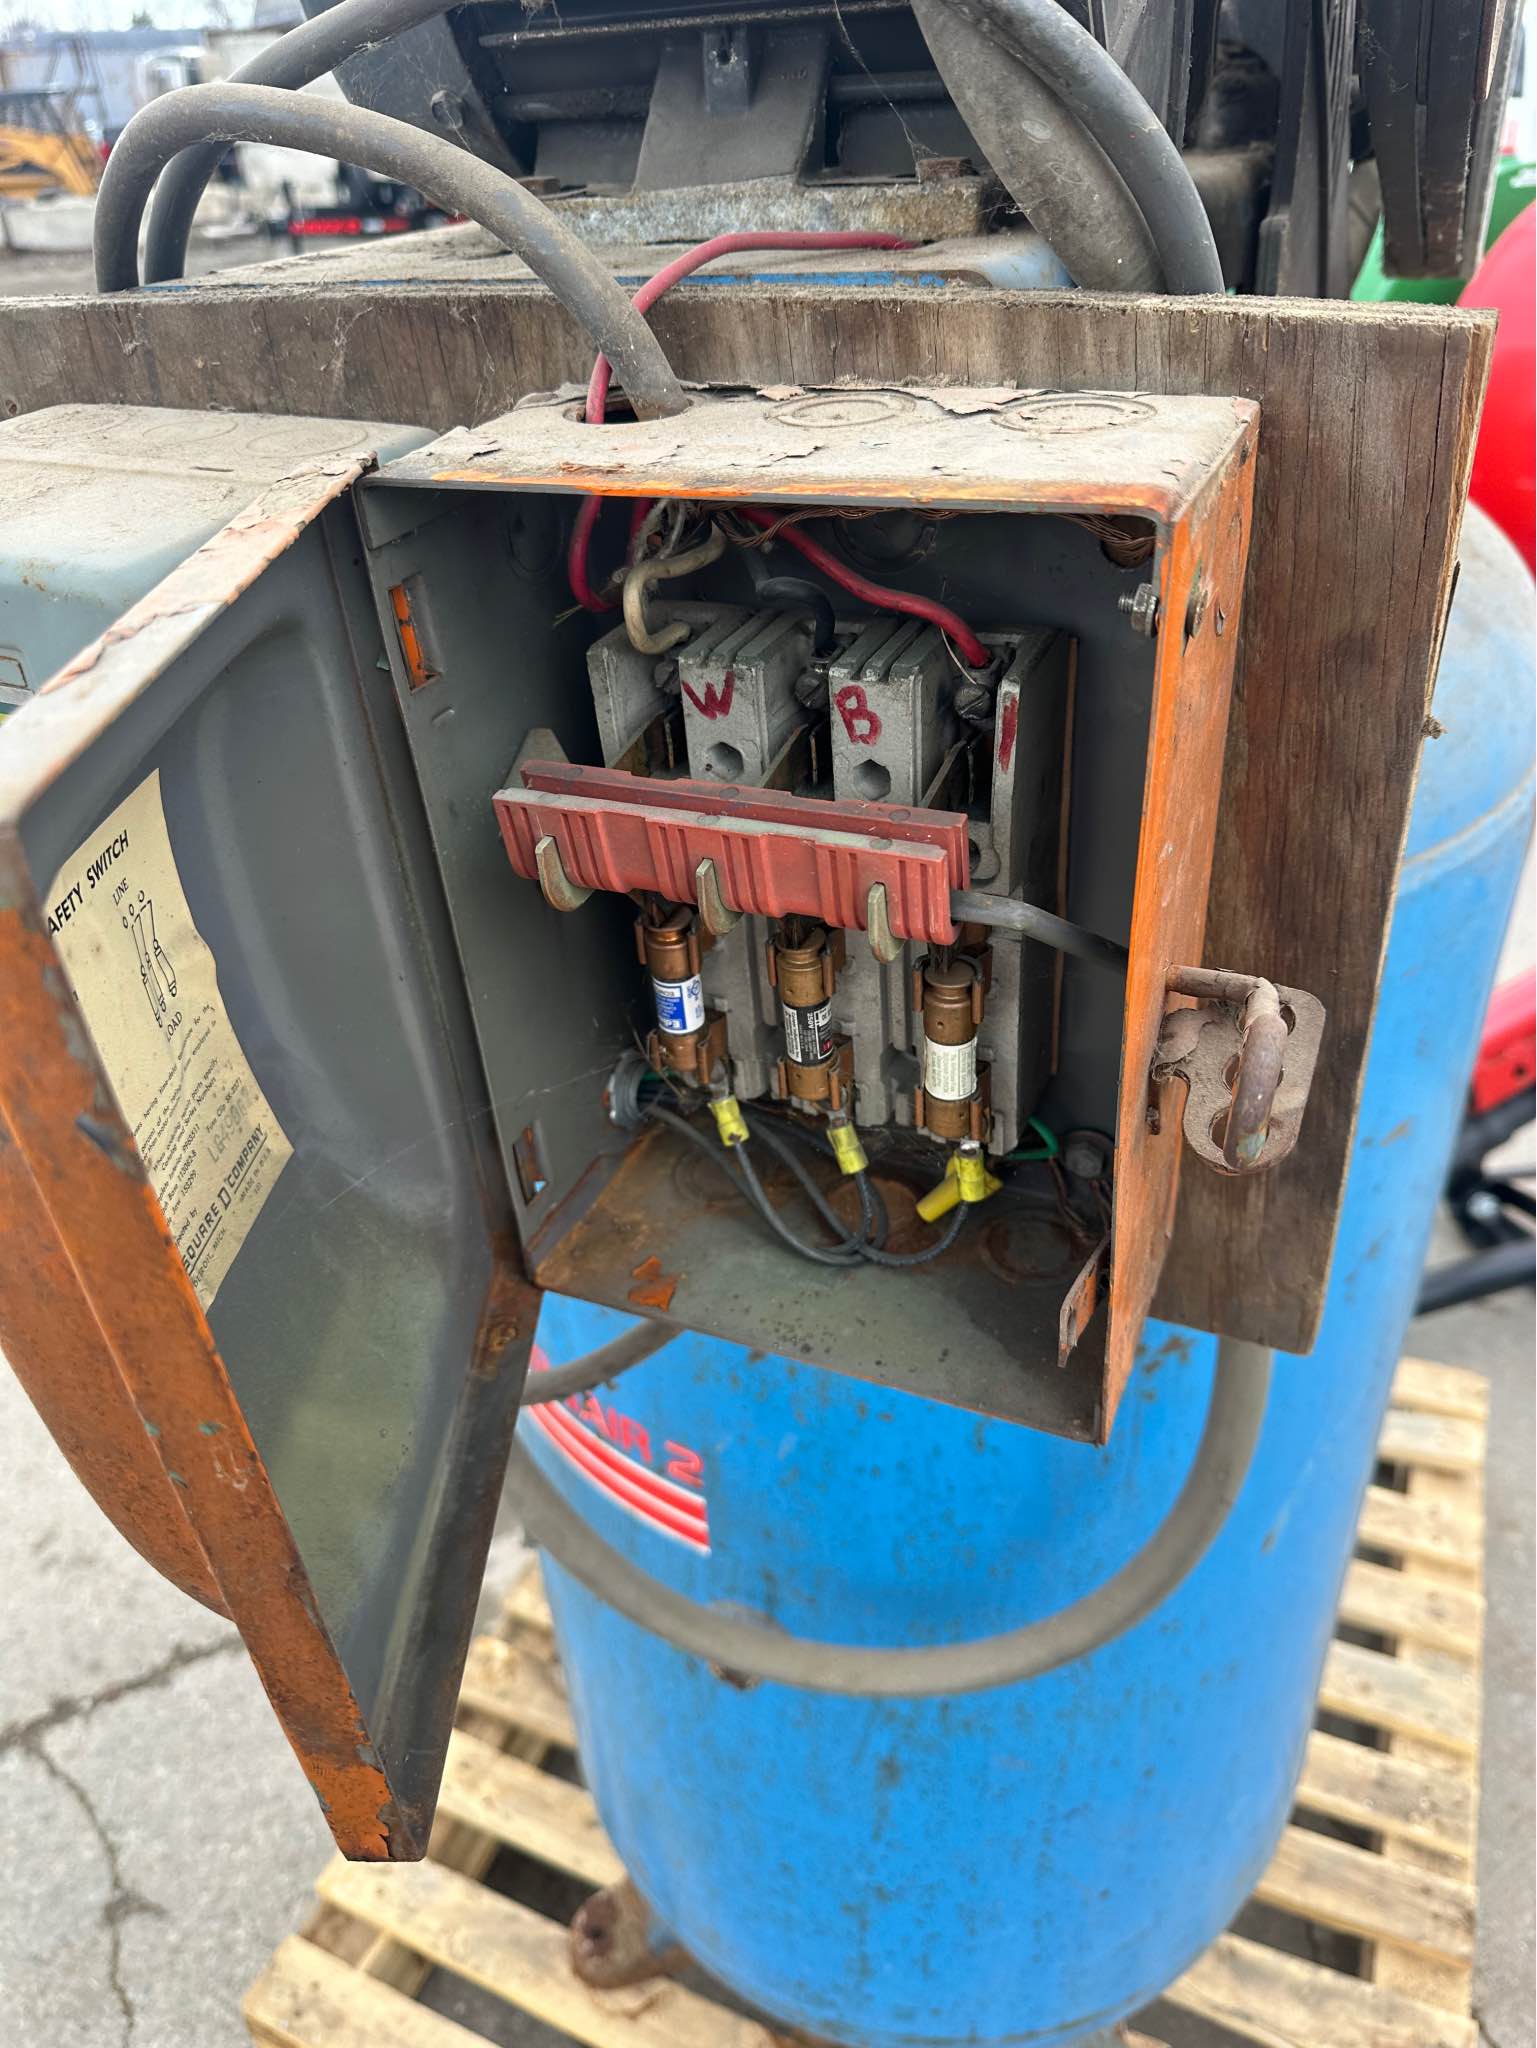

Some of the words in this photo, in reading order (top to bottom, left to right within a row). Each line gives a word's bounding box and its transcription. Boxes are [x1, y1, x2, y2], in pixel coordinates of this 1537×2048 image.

[682, 671, 735, 720] W
[834, 685, 882, 746] B
[48, 882, 84, 934] AFETY
[87, 830, 129, 889] SWITCH
[112, 877, 130, 907] LINE
[166, 1011, 183, 1042] LOAD
[807, 1012, 815, 1029] 250V
[182, 1202, 220, 1272] SQUARE
[217, 1186, 232, 1211] D
[227, 1122, 264, 1189] COMPANY
[566, 1390, 653, 1463] AIR
[664, 1440, 704, 1488] 2
